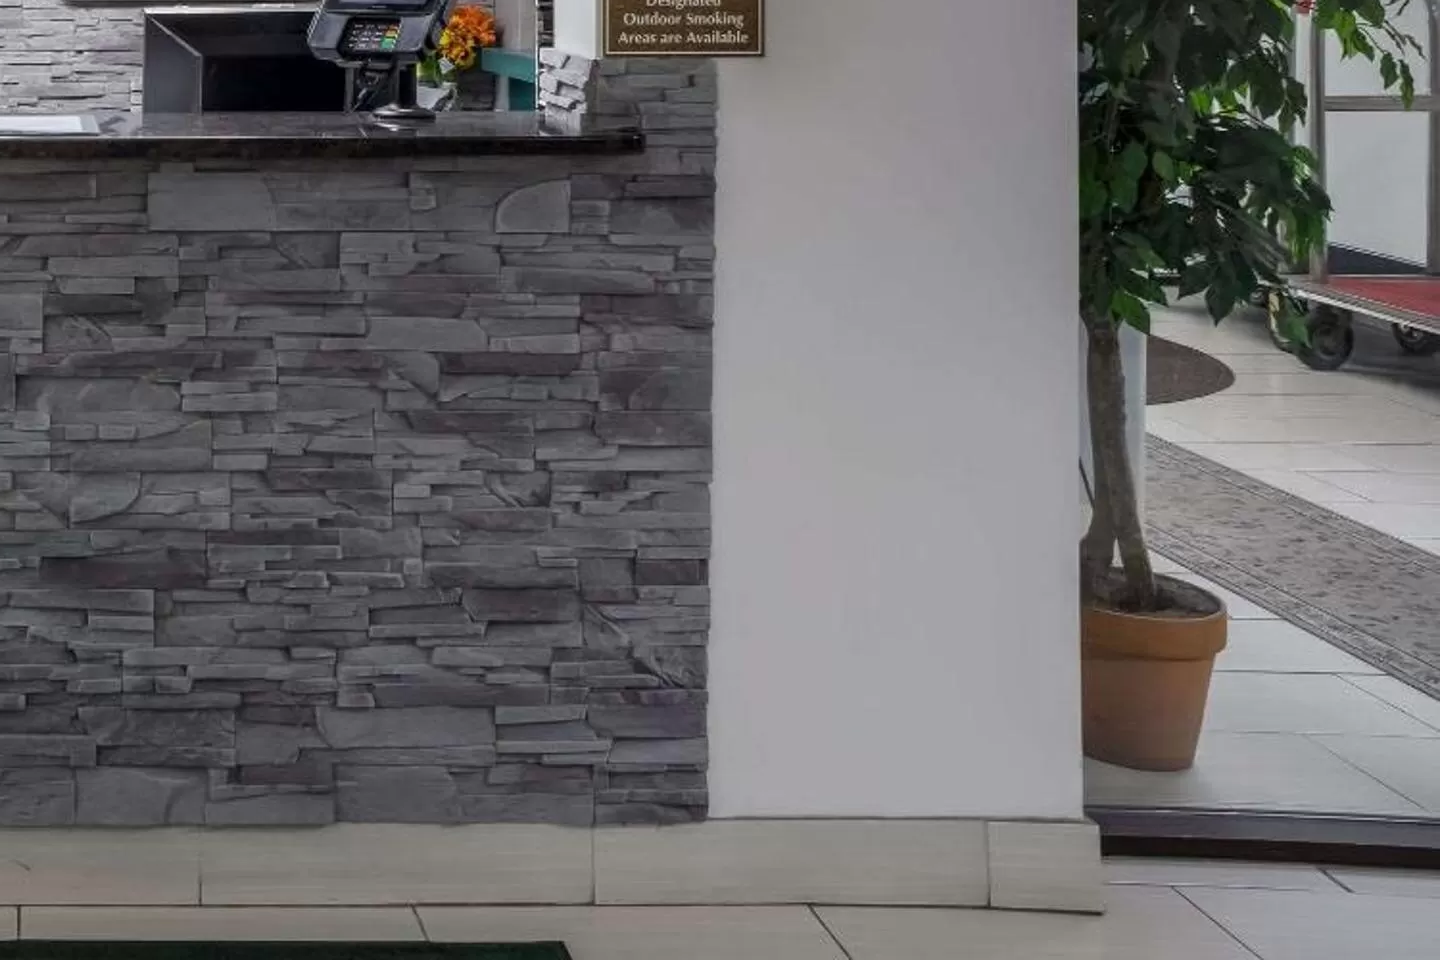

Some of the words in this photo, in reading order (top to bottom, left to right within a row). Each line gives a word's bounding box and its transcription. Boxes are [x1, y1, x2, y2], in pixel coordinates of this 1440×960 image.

[623, 12, 681, 26] Outdoor
[685, 12, 745, 29] Smoking
[618, 31, 656, 45] Areas
[659, 34, 682, 45] are
[686, 31, 750, 45] Available
